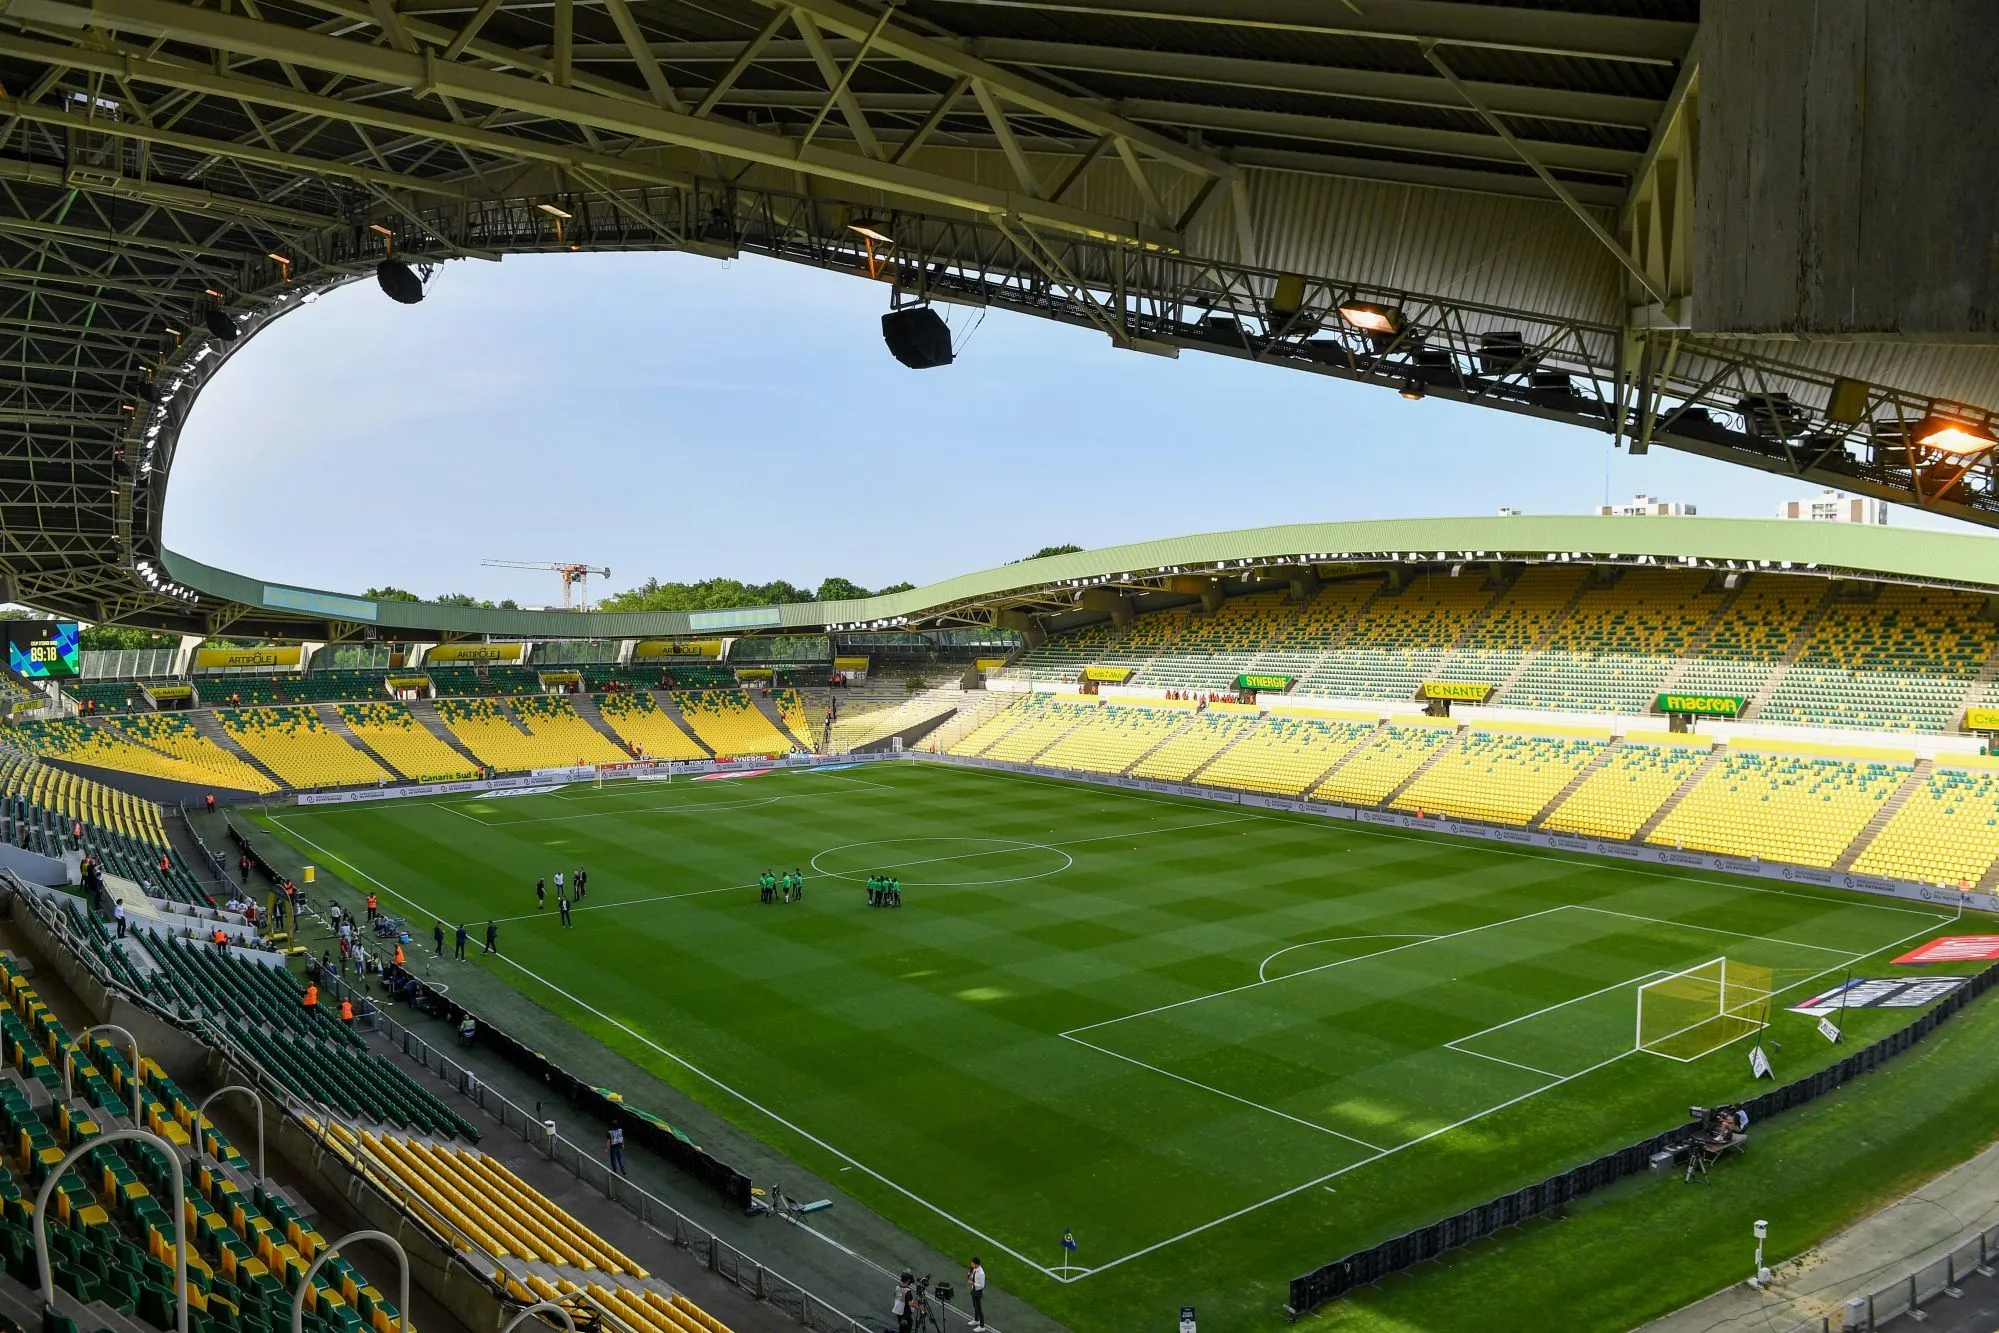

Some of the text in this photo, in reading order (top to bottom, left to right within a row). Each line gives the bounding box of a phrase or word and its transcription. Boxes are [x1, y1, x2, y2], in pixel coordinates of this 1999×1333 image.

[30, 646, 57, 662] 89:18
[228, 652, 272, 664] ARTIPÔLE
[457, 648, 496, 658] ARTIPÔLE
[1246, 676, 1287, 688] SYNERGIE
[1426, 685, 1440, 694] FC
[1667, 696, 1737, 712] macron
[421, 773, 453, 783] Canaris
[456, 771, 471, 779] Sud
